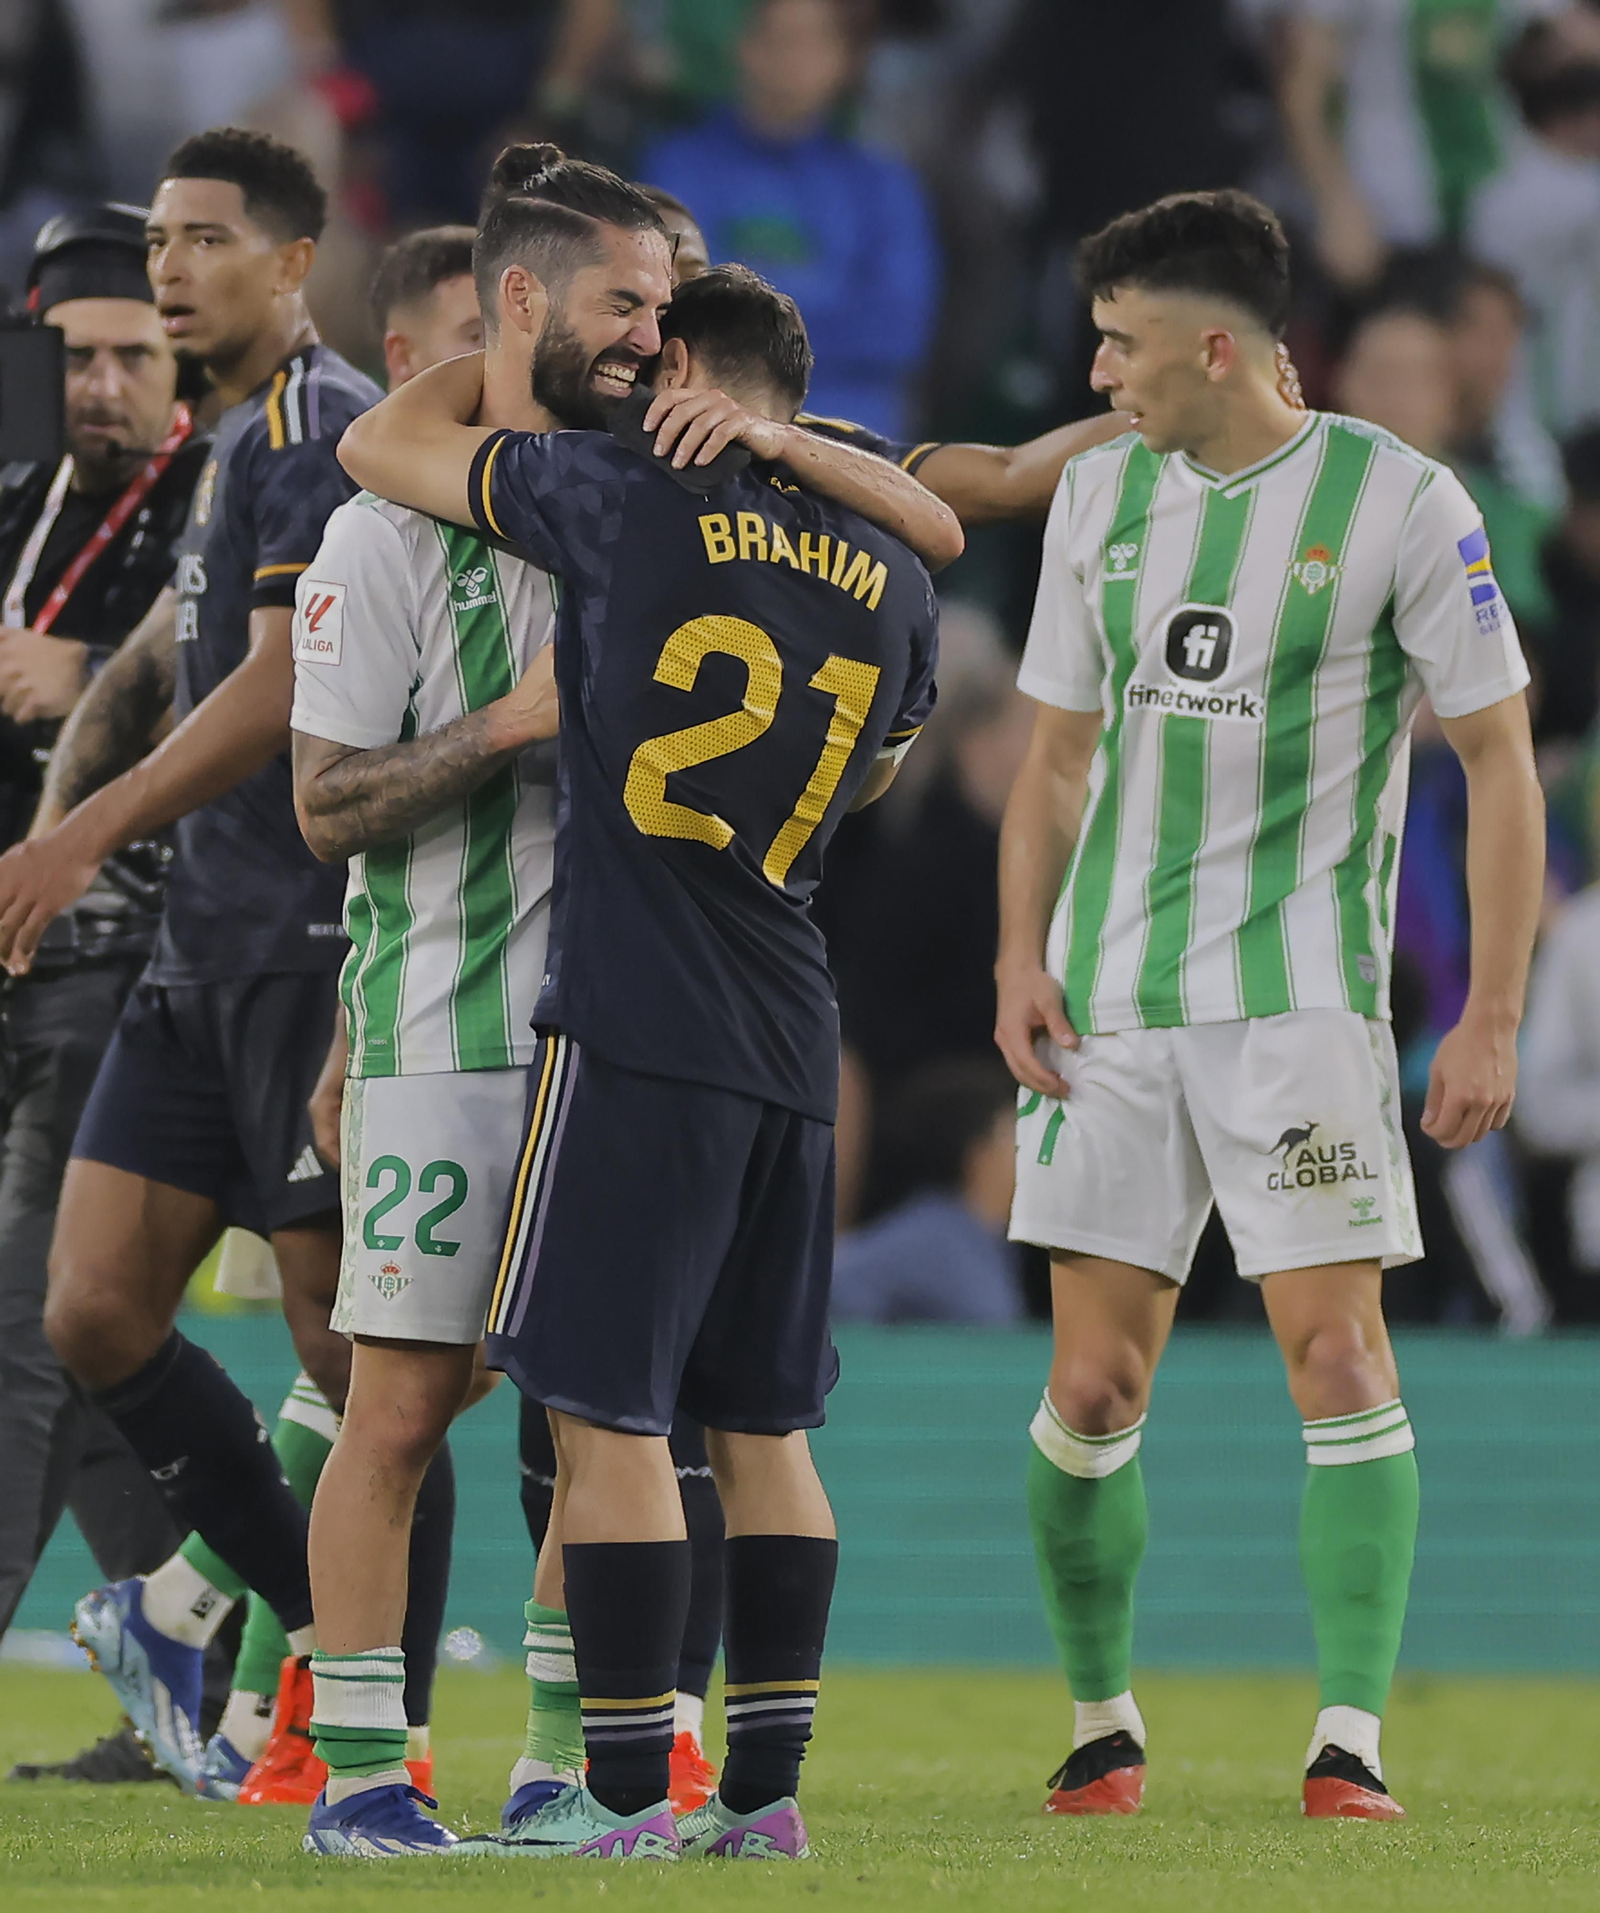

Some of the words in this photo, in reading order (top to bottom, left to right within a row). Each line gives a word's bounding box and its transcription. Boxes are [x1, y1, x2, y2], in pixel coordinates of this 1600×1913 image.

[697, 511, 888, 612] BRAHIM
[454, 591, 497, 612] hummel
[1129, 684, 1258, 718] finetwork
[623, 614, 881, 889] 21
[1296, 1142, 1356, 1167] AUS
[1267, 1161, 1378, 1190] GLOBAL
[363, 1155, 468, 1257] 22
